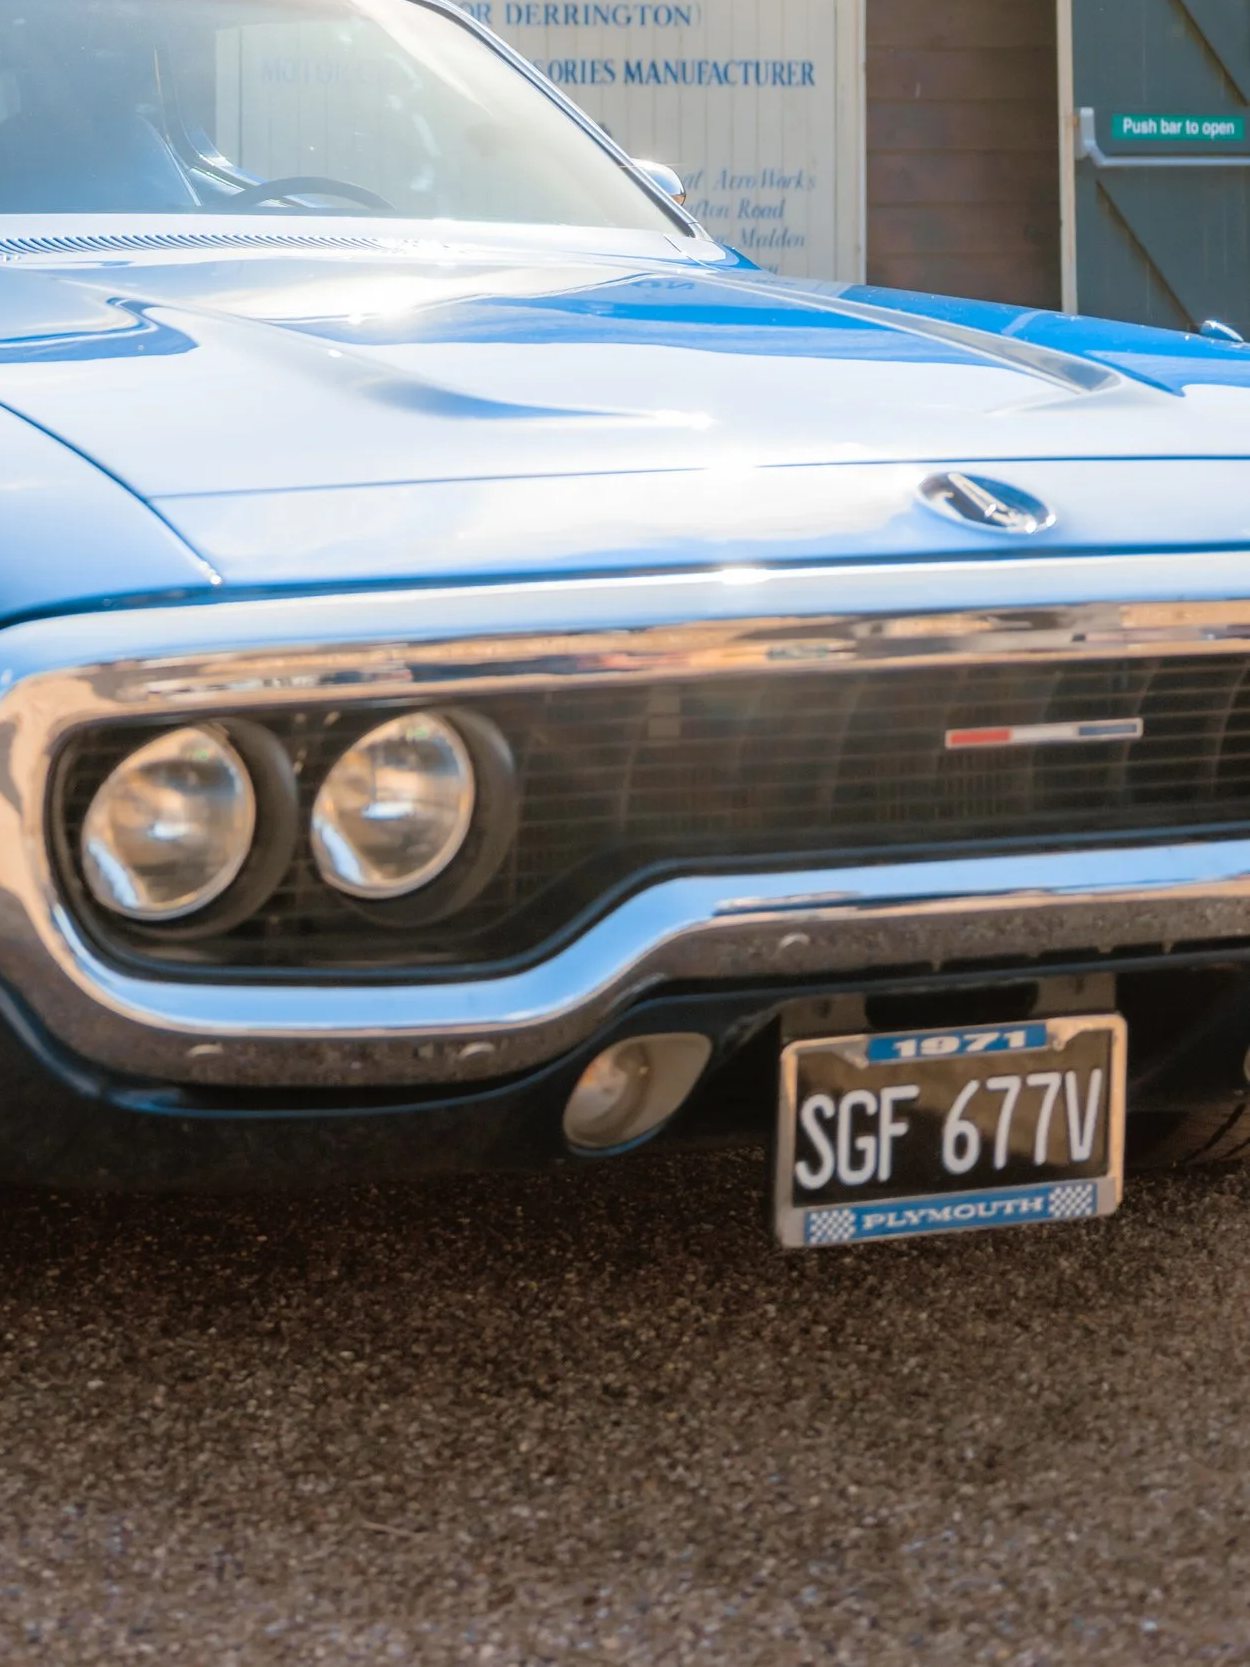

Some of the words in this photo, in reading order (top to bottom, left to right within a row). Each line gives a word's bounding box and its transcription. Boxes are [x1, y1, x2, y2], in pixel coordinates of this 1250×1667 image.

[624, 57, 816, 87] MANUFACTURER
[1122, 117, 1158, 135] Push
[1160, 118, 1183, 135] bar
[1185, 119, 1200, 135] to
[1202, 121, 1235, 140] open
[736, 198, 786, 220] Road
[739, 227, 805, 248] Malden
[892, 1029, 1027, 1058] 1971
[795, 1084, 921, 1191] SGF
[942, 1067, 1103, 1176] 677V
[861, 1195, 1045, 1231] PLYMOUTH
